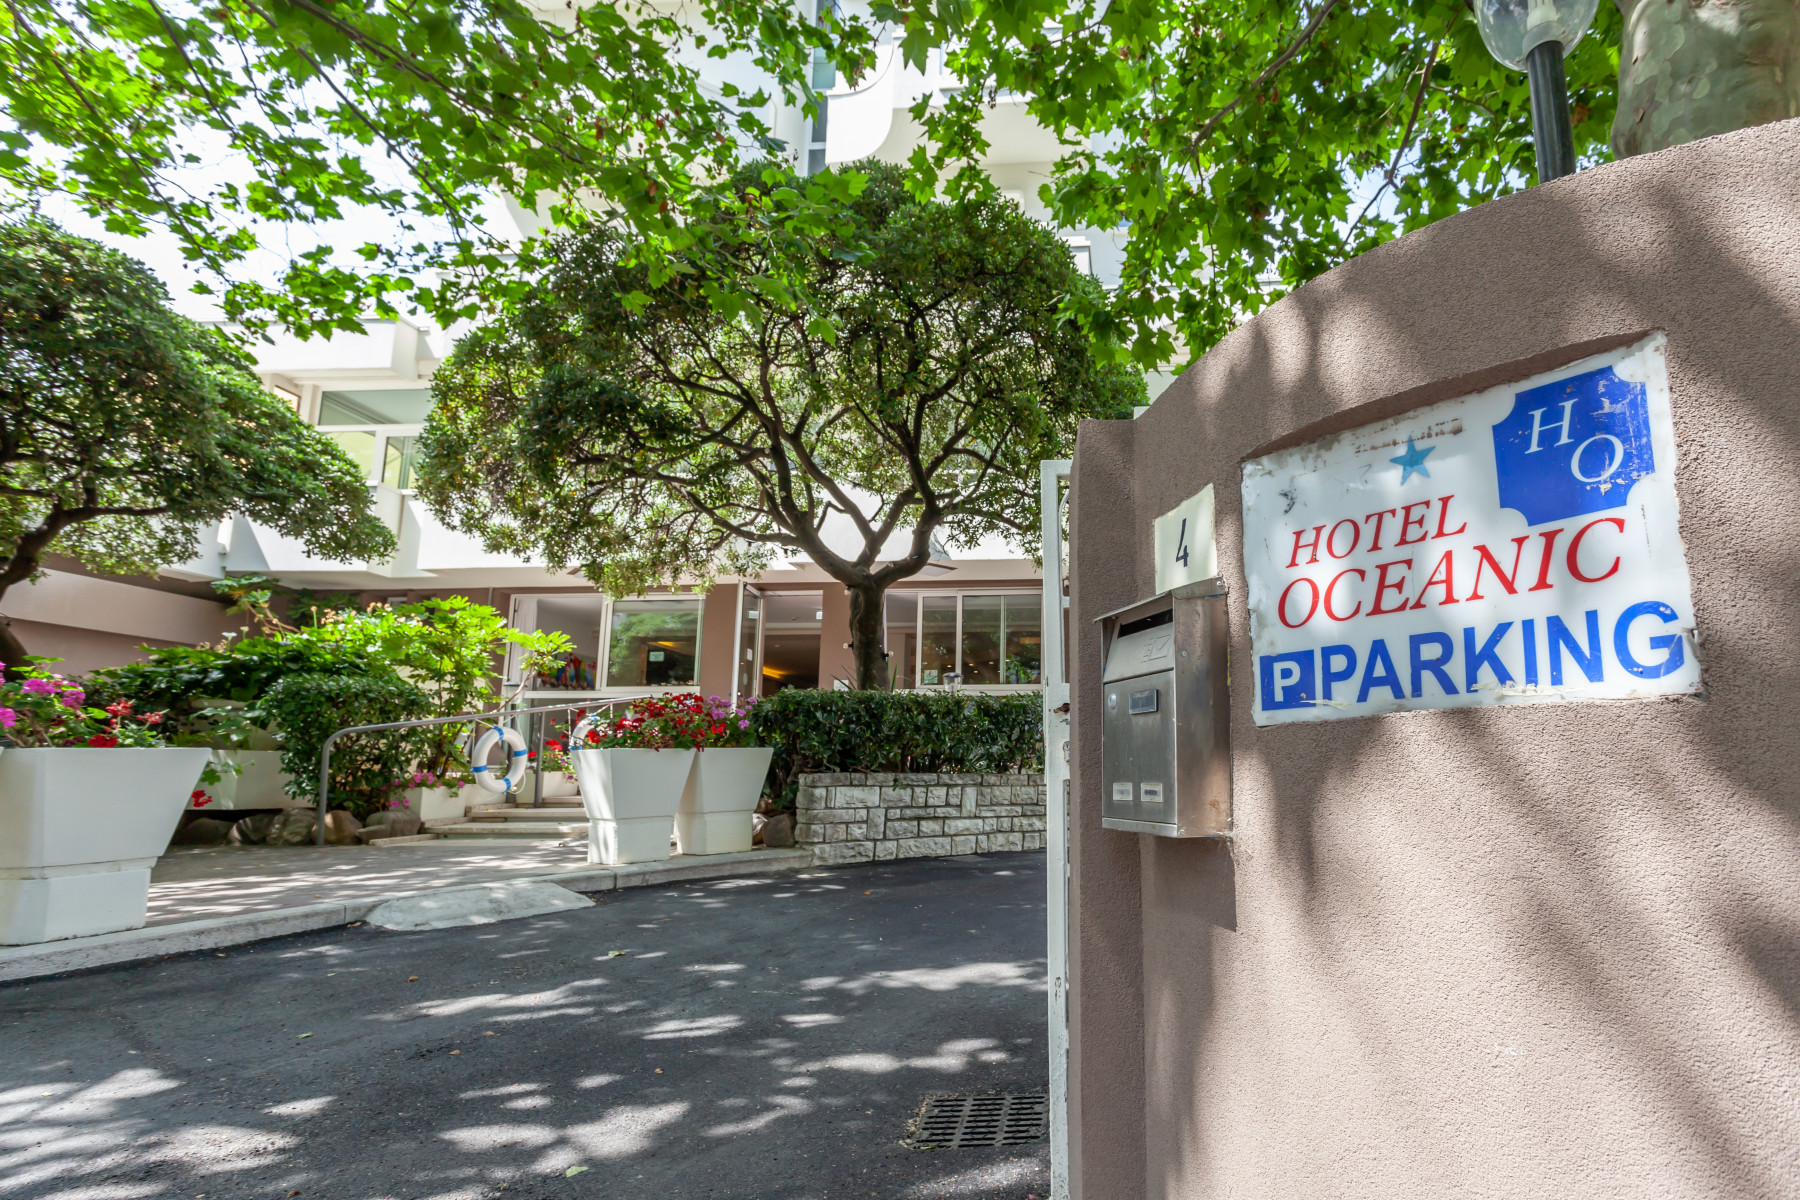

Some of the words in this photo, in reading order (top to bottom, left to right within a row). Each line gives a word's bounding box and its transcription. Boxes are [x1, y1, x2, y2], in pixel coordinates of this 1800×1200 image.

[1175, 517, 1189, 568] 4
[1277, 517, 1625, 628] OCEANIC
[1285, 494, 1467, 568] HOTEL
[1273, 661, 1300, 702] P
[1321, 600, 1684, 703] PARKING
